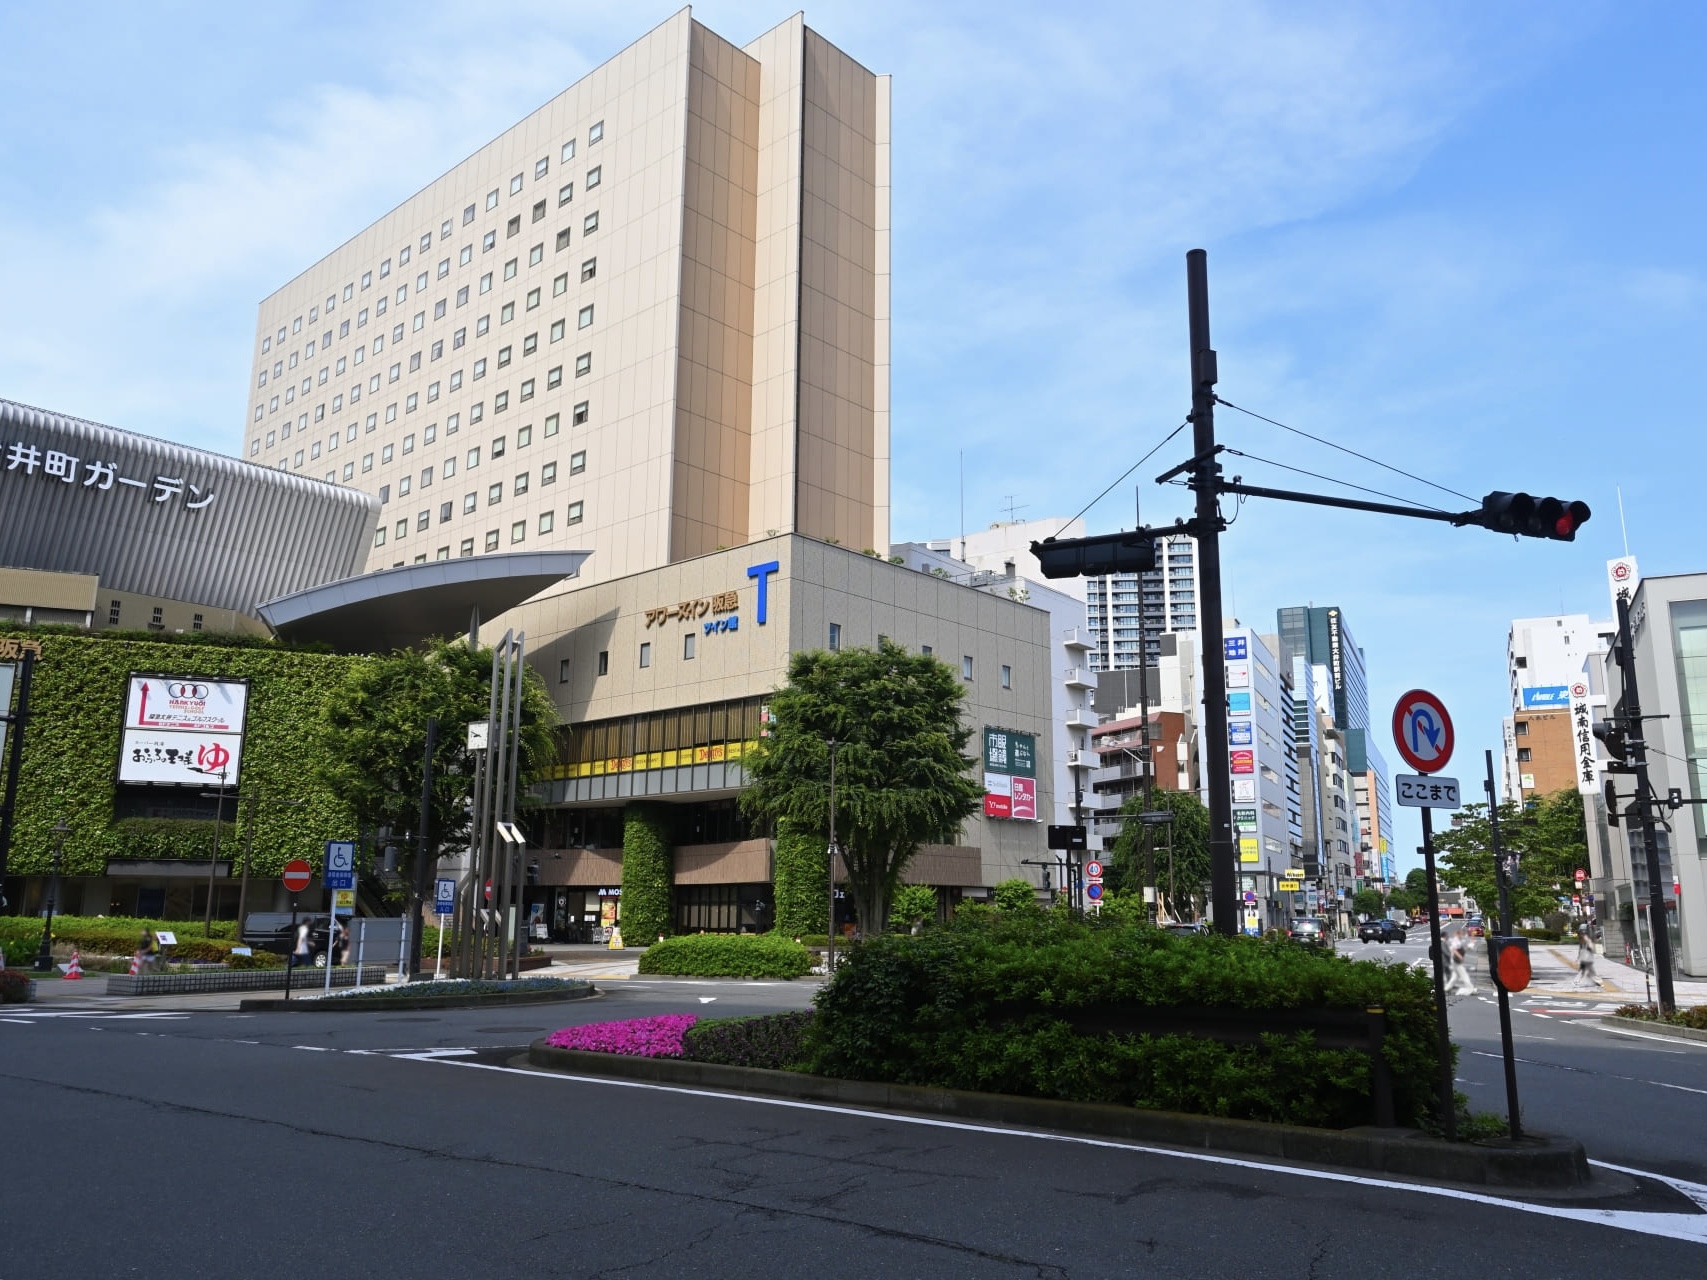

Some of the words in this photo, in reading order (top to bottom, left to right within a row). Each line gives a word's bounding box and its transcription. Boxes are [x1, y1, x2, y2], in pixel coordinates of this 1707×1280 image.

[0, 442, 214, 508] 井町ガーデン
[747, 561, 779, 624] T
[1574, 703, 1596, 784] 城南信用金庫
[1401, 782, 1457, 801] ここまで
